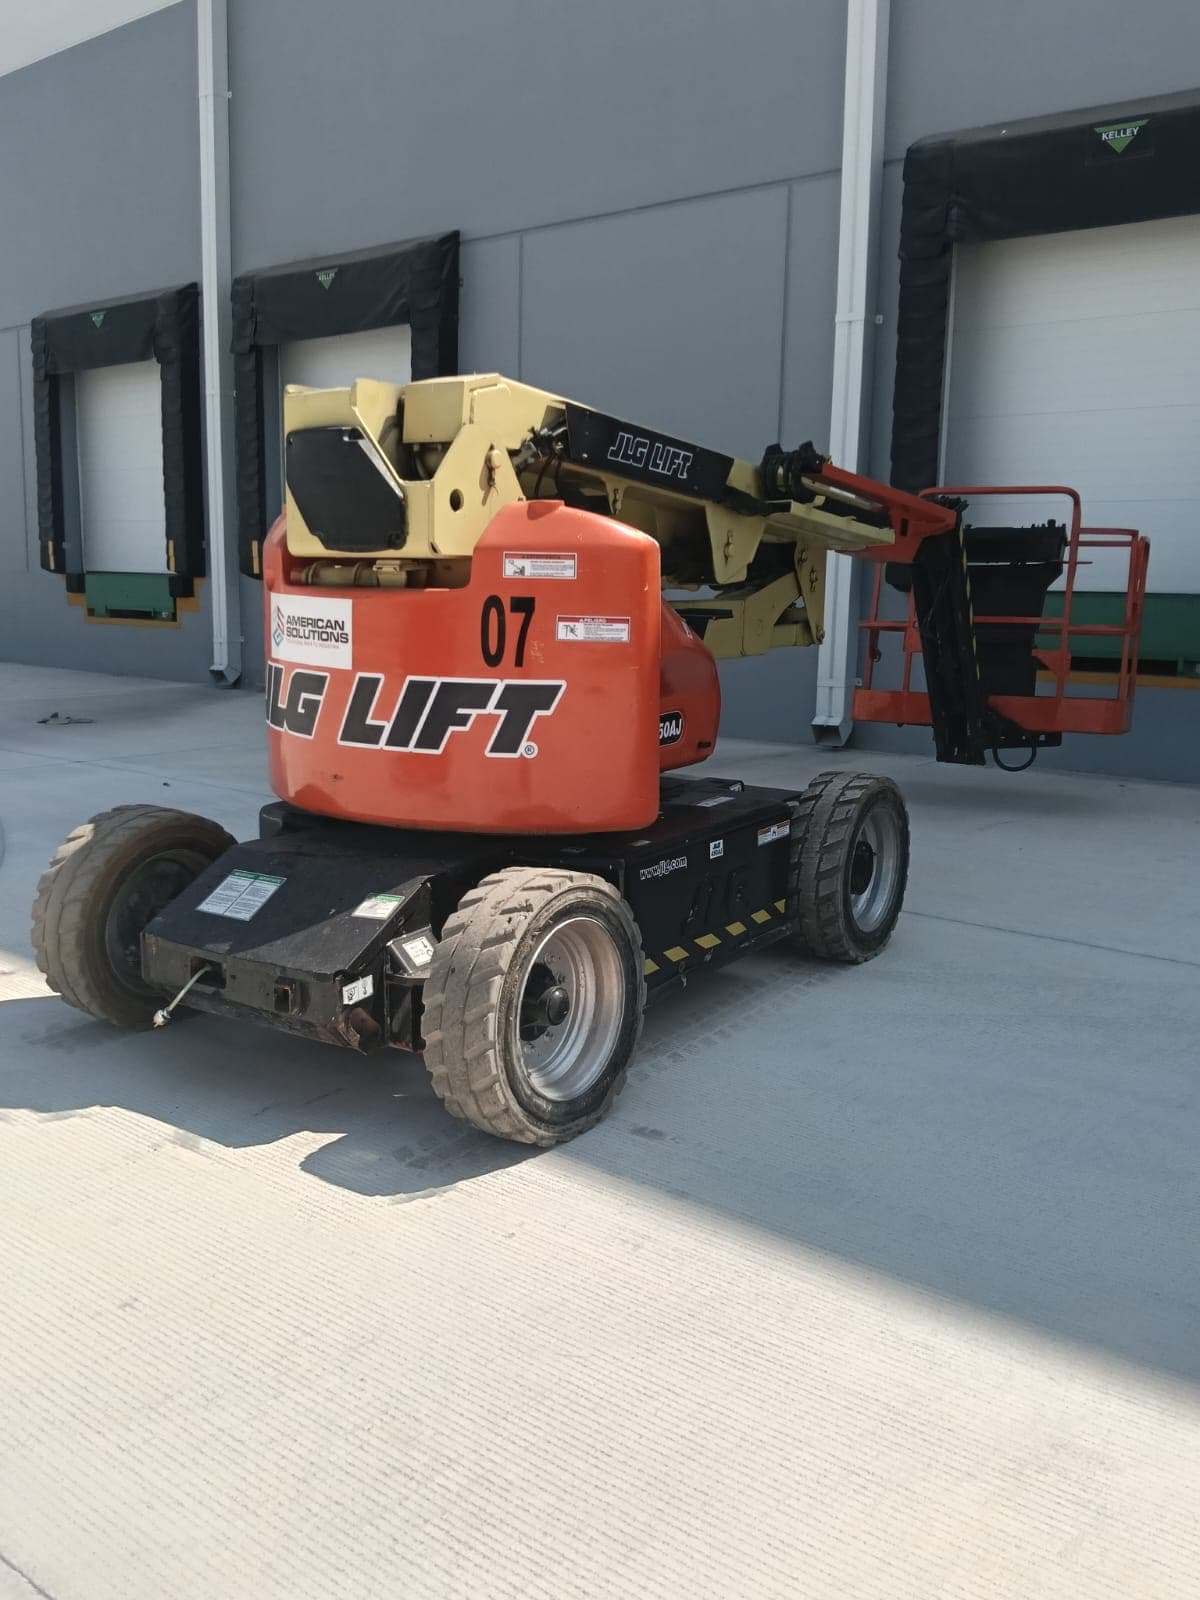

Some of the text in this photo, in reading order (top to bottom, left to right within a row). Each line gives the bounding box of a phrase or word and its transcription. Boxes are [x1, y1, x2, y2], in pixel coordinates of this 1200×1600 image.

[1101, 126, 1139, 141] KELLEY
[608, 432, 693, 479] JLG LIFT
[286, 614, 345, 632] AMERICAN
[286, 626, 349, 644] SOLUTIONS
[480, 594, 536, 668] 07
[337, 672, 567, 758] LIFT
[640, 856, 688, 880] www.jlg.com
